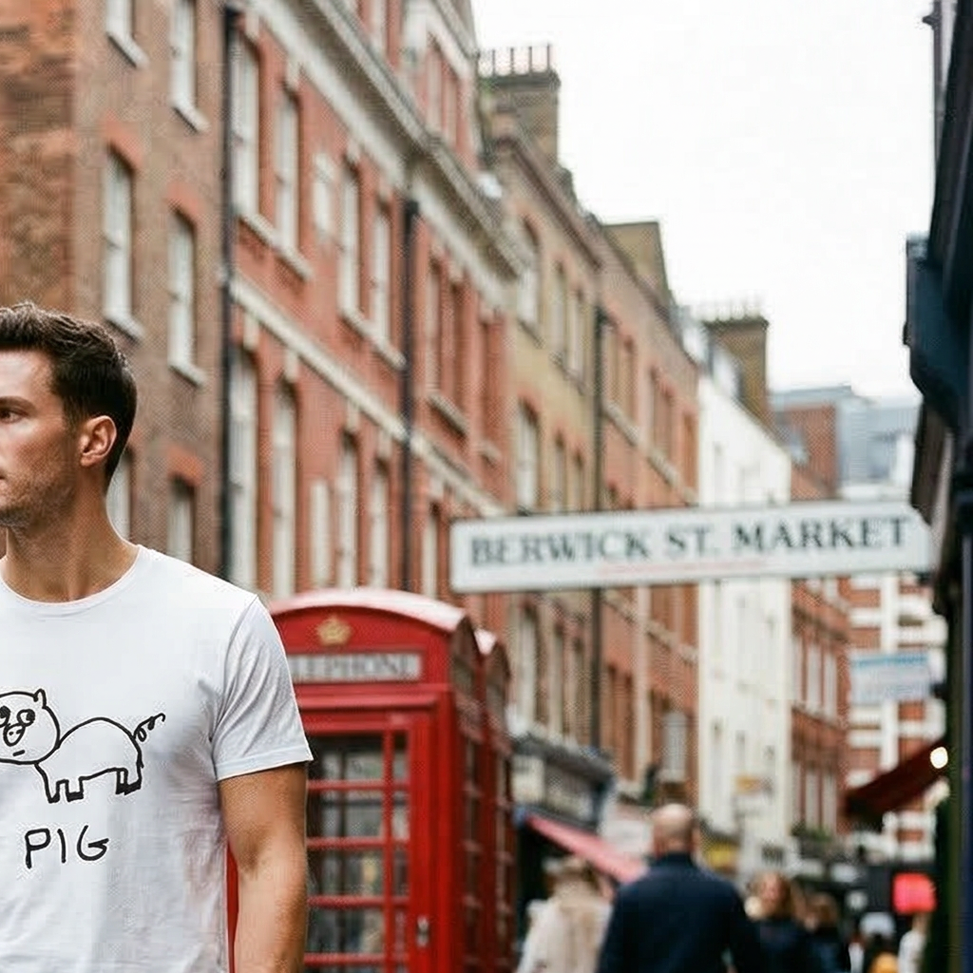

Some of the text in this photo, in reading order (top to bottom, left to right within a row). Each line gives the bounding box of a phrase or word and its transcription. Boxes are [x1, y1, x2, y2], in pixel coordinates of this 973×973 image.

[471, 531, 649, 567] BERWICK
[667, 525, 719, 557] ST.
[732, 516, 911, 553] MARKET
[291, 654, 413, 677] LEPHONE
[24, 825, 110, 870] PIG
